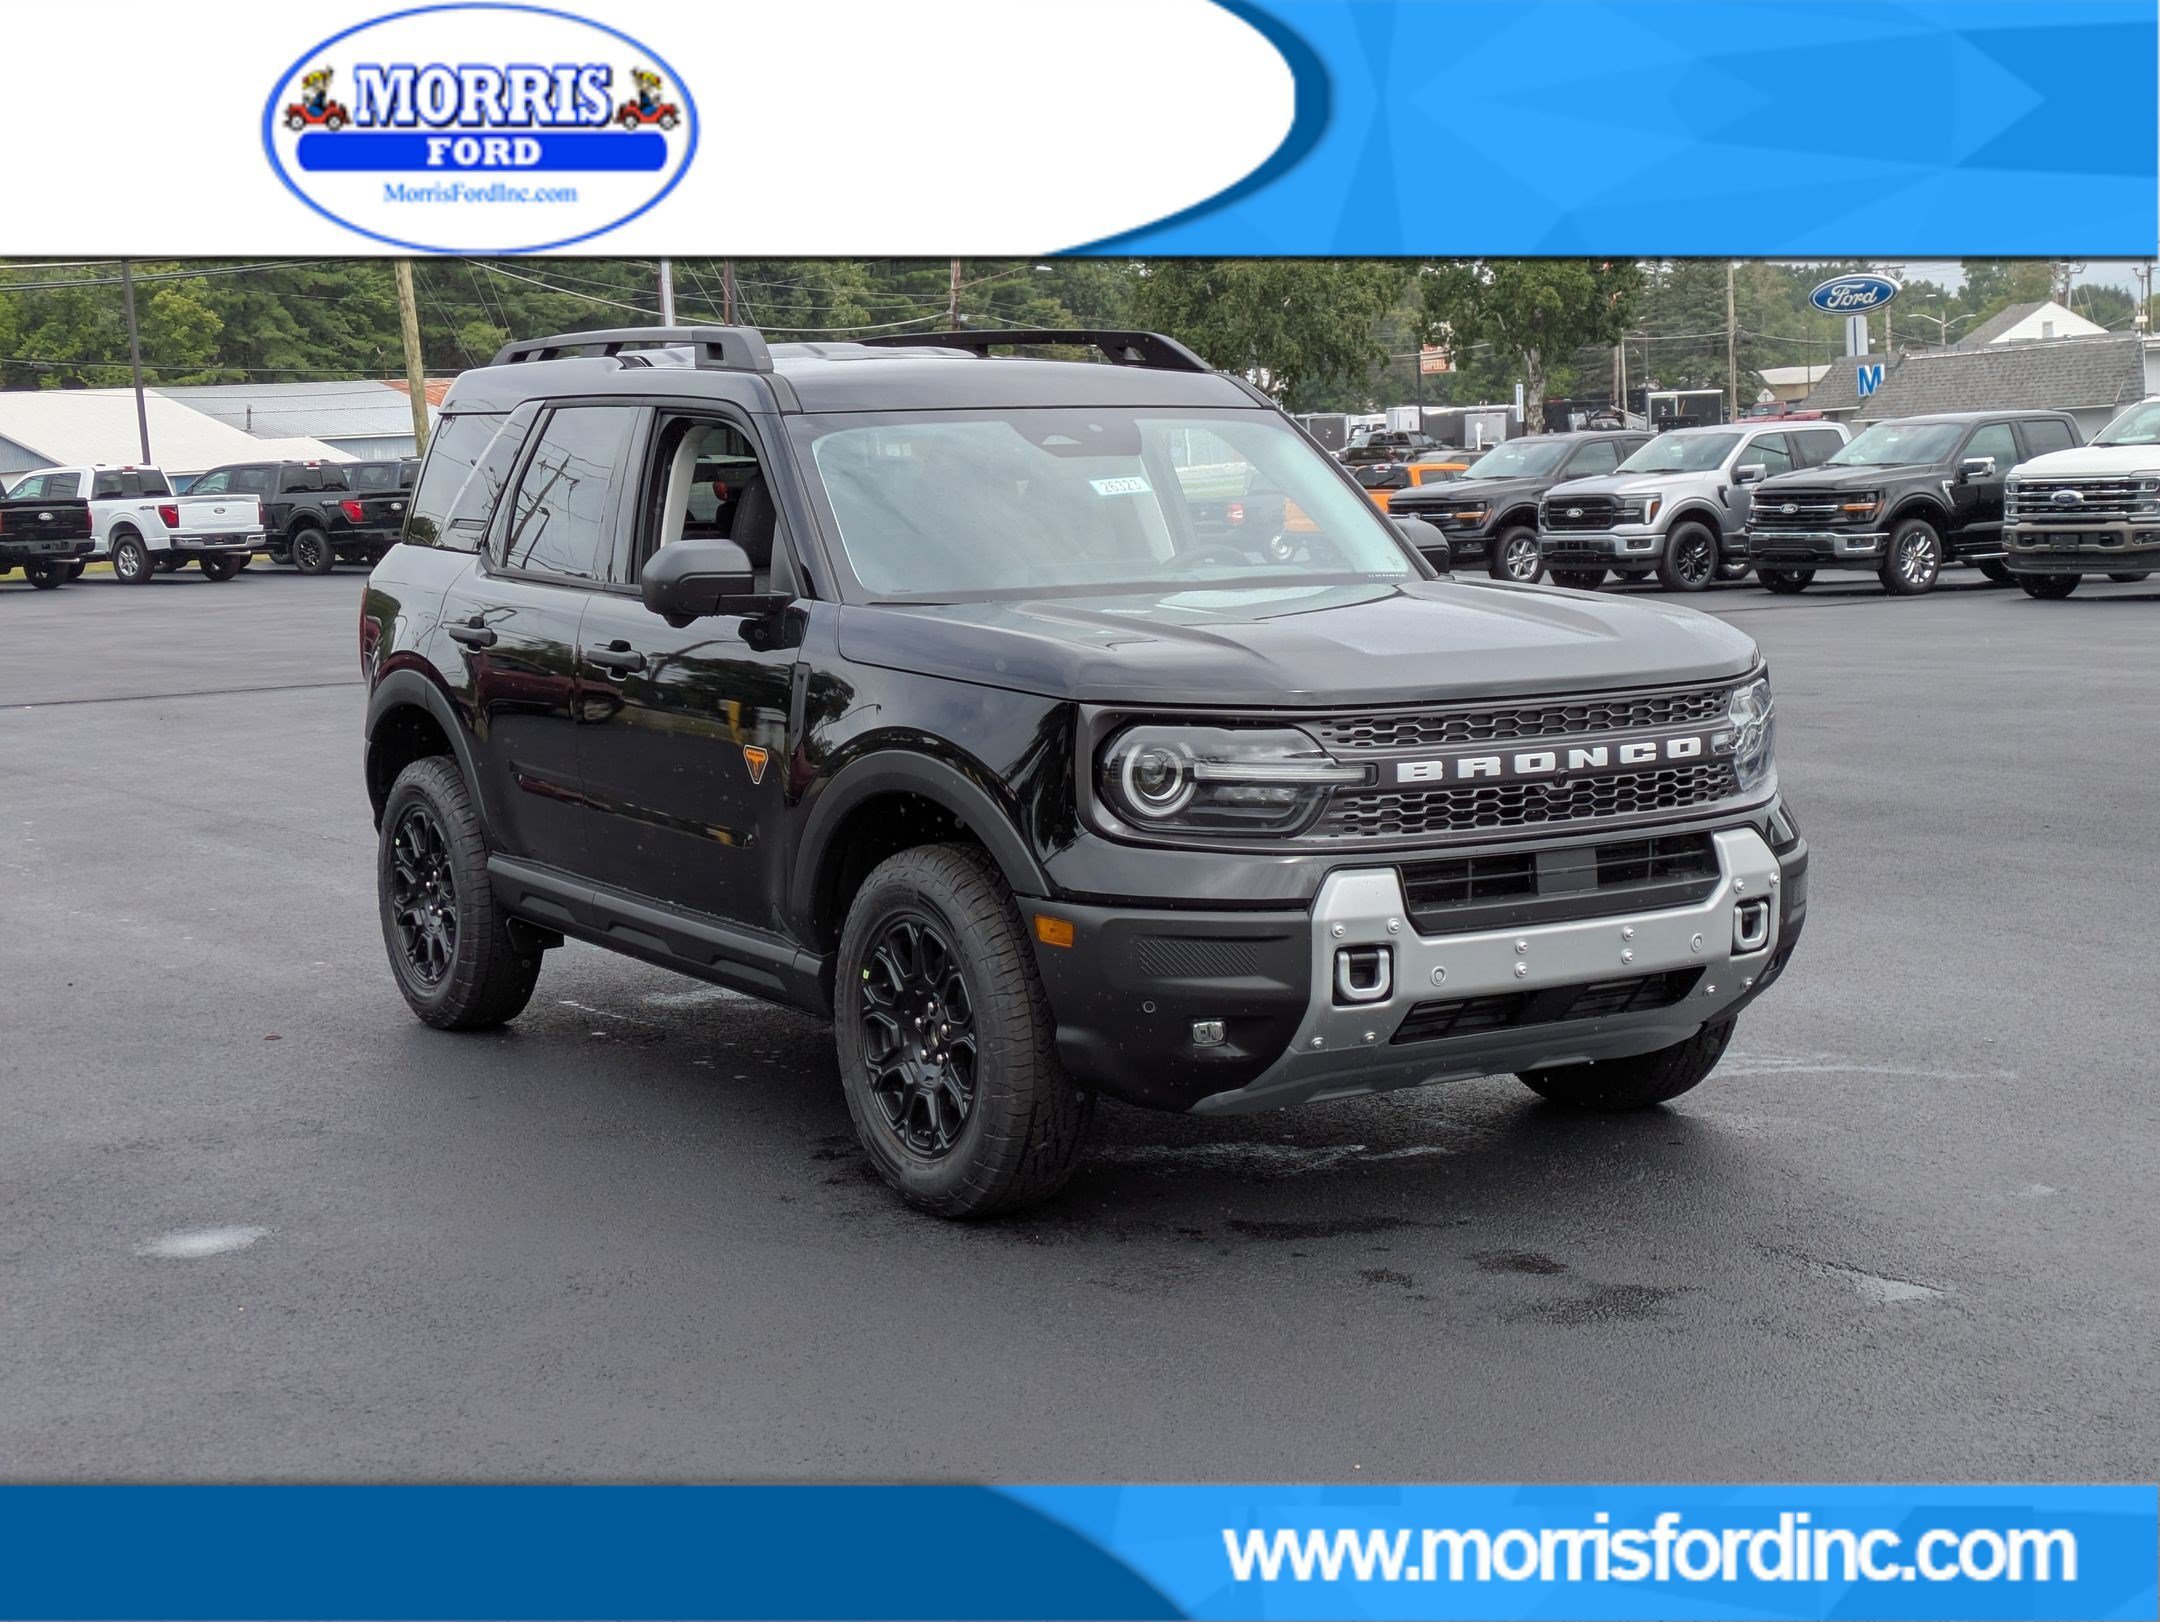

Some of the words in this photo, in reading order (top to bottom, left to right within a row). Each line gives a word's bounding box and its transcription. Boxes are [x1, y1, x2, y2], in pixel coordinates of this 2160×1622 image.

[1826, 283, 1879, 308] Ford
[1100, 479, 1142, 493] 26323
[1397, 737, 1701, 783] BRONCO
